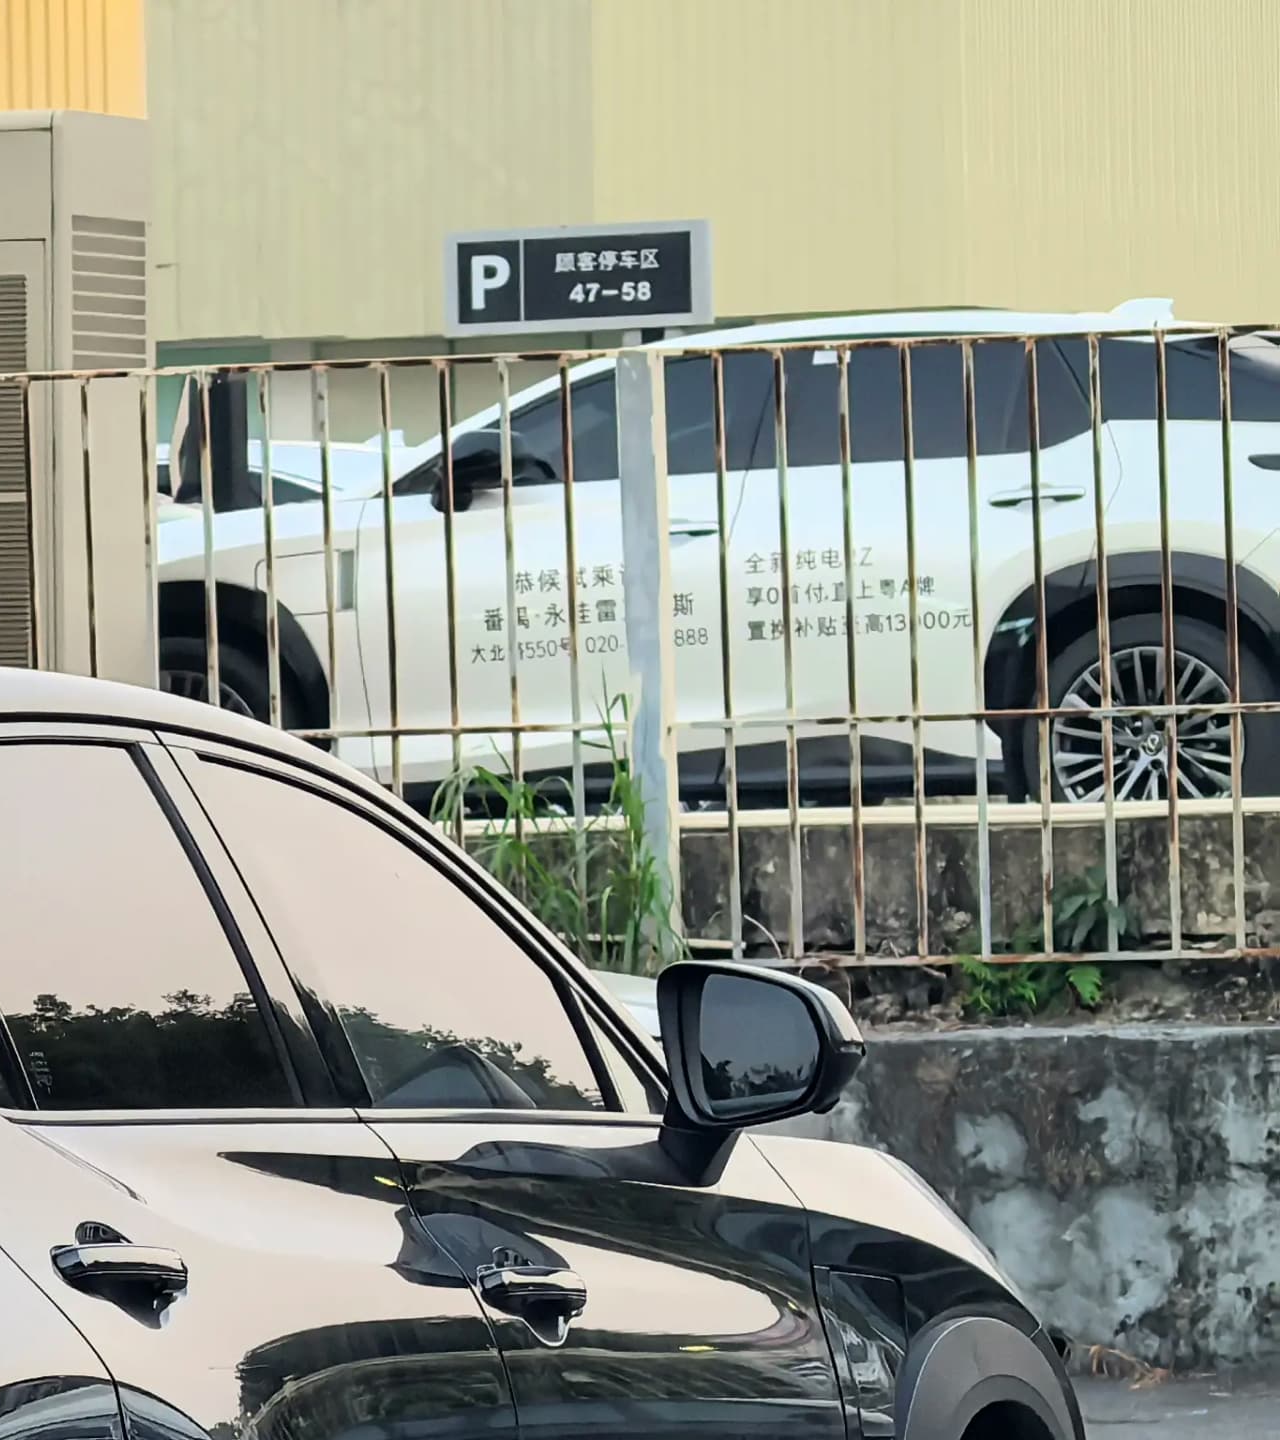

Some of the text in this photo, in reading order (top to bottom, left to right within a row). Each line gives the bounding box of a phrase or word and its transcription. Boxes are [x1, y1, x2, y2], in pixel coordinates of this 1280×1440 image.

[555, 248, 660, 273] 顾客停车区
[470, 254, 512, 311] P
[569, 281, 653, 304] 47-58
[744, 546, 874, 575] 全新纯电Z
[747, 607, 974, 642] 置换补贴至高1300元
